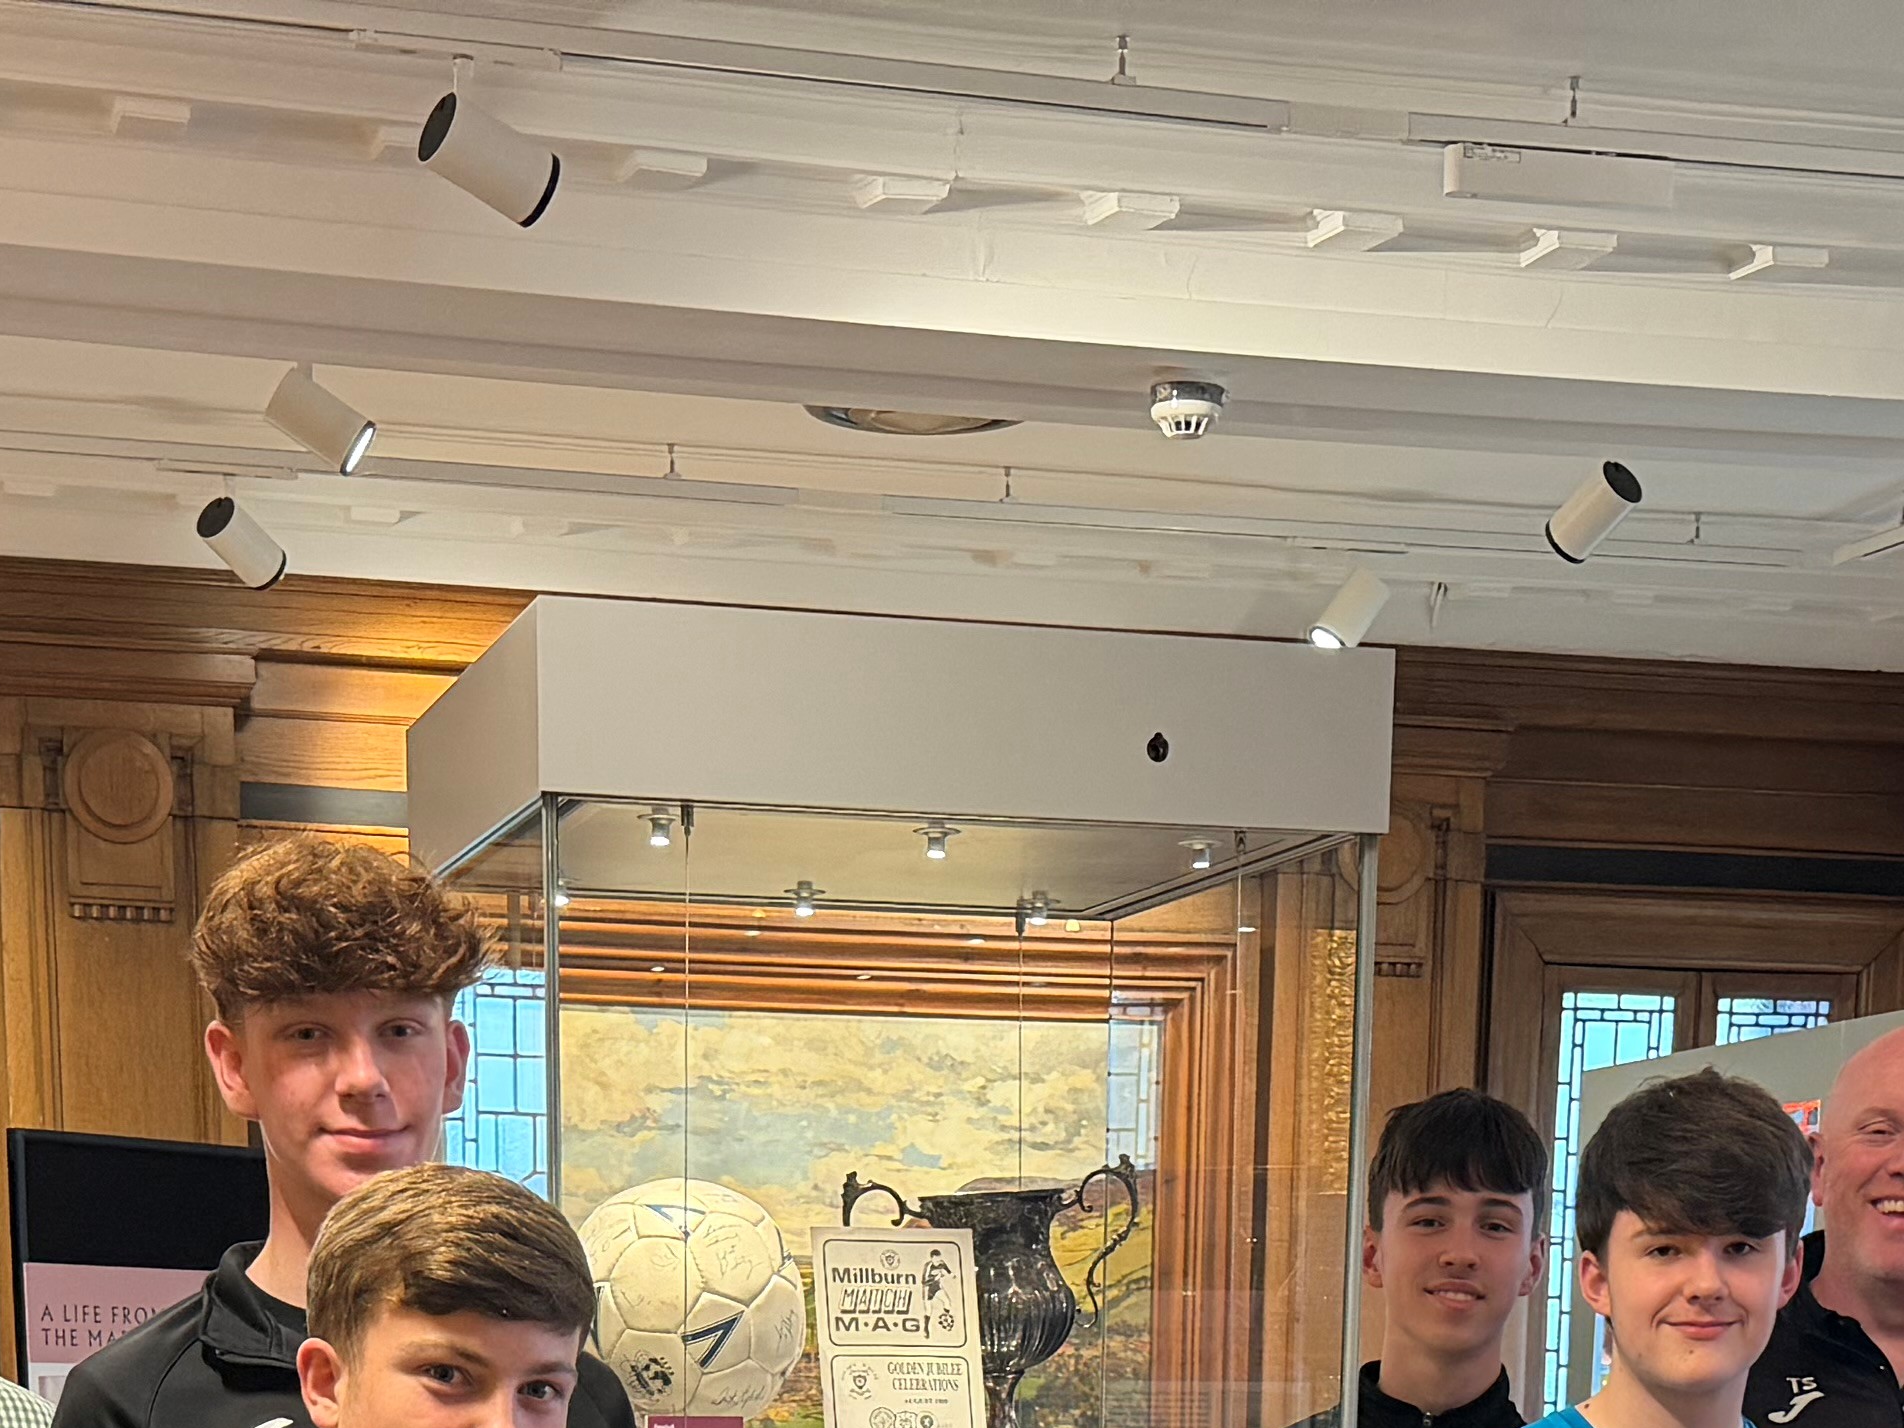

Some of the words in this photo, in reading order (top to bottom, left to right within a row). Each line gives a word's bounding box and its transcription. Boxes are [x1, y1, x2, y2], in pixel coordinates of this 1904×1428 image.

[832, 1267, 917, 1285] Millburn
[839, 1286, 913, 1315] MATCH
[41, 1304, 53, 1321] A
[64, 1304, 101, 1323] LIFE
[111, 1306, 156, 1325] FRO
[41, 1328, 78, 1347] THE
[887, 1361, 924, 1375] GOLDEN
[927, 1362, 963, 1376] JUBILEE
[892, 1378, 959, 1391] CELEBRATIONS
[1786, 1376, 1817, 1393] TS
